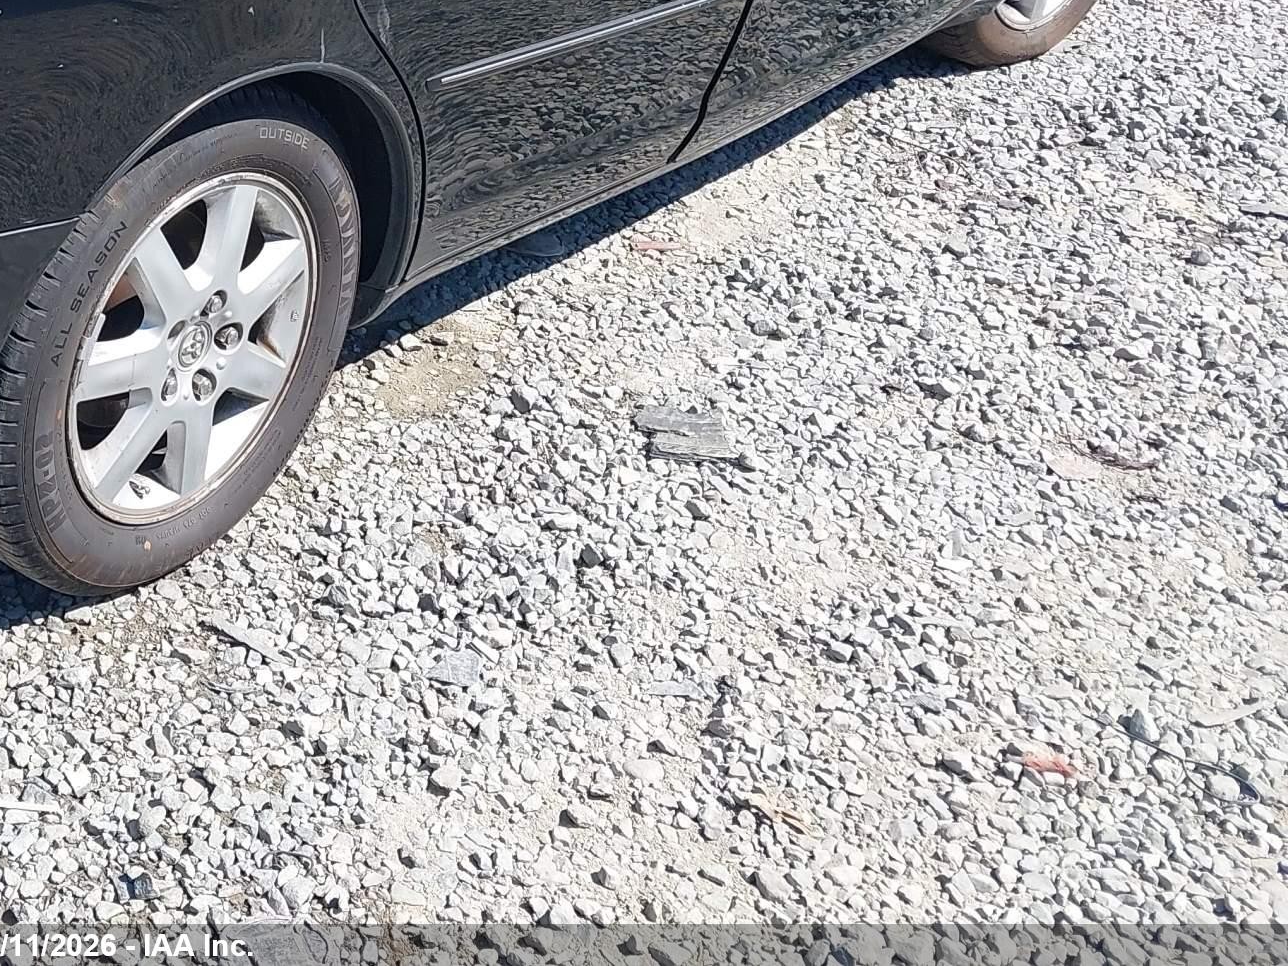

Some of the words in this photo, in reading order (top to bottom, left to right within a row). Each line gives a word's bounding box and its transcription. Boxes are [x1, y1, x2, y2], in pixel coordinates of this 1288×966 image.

[259, 127, 310, 150] OUTSIDE
[50, 322, 73, 368] ALL
[69, 220, 129, 314] SEASON
